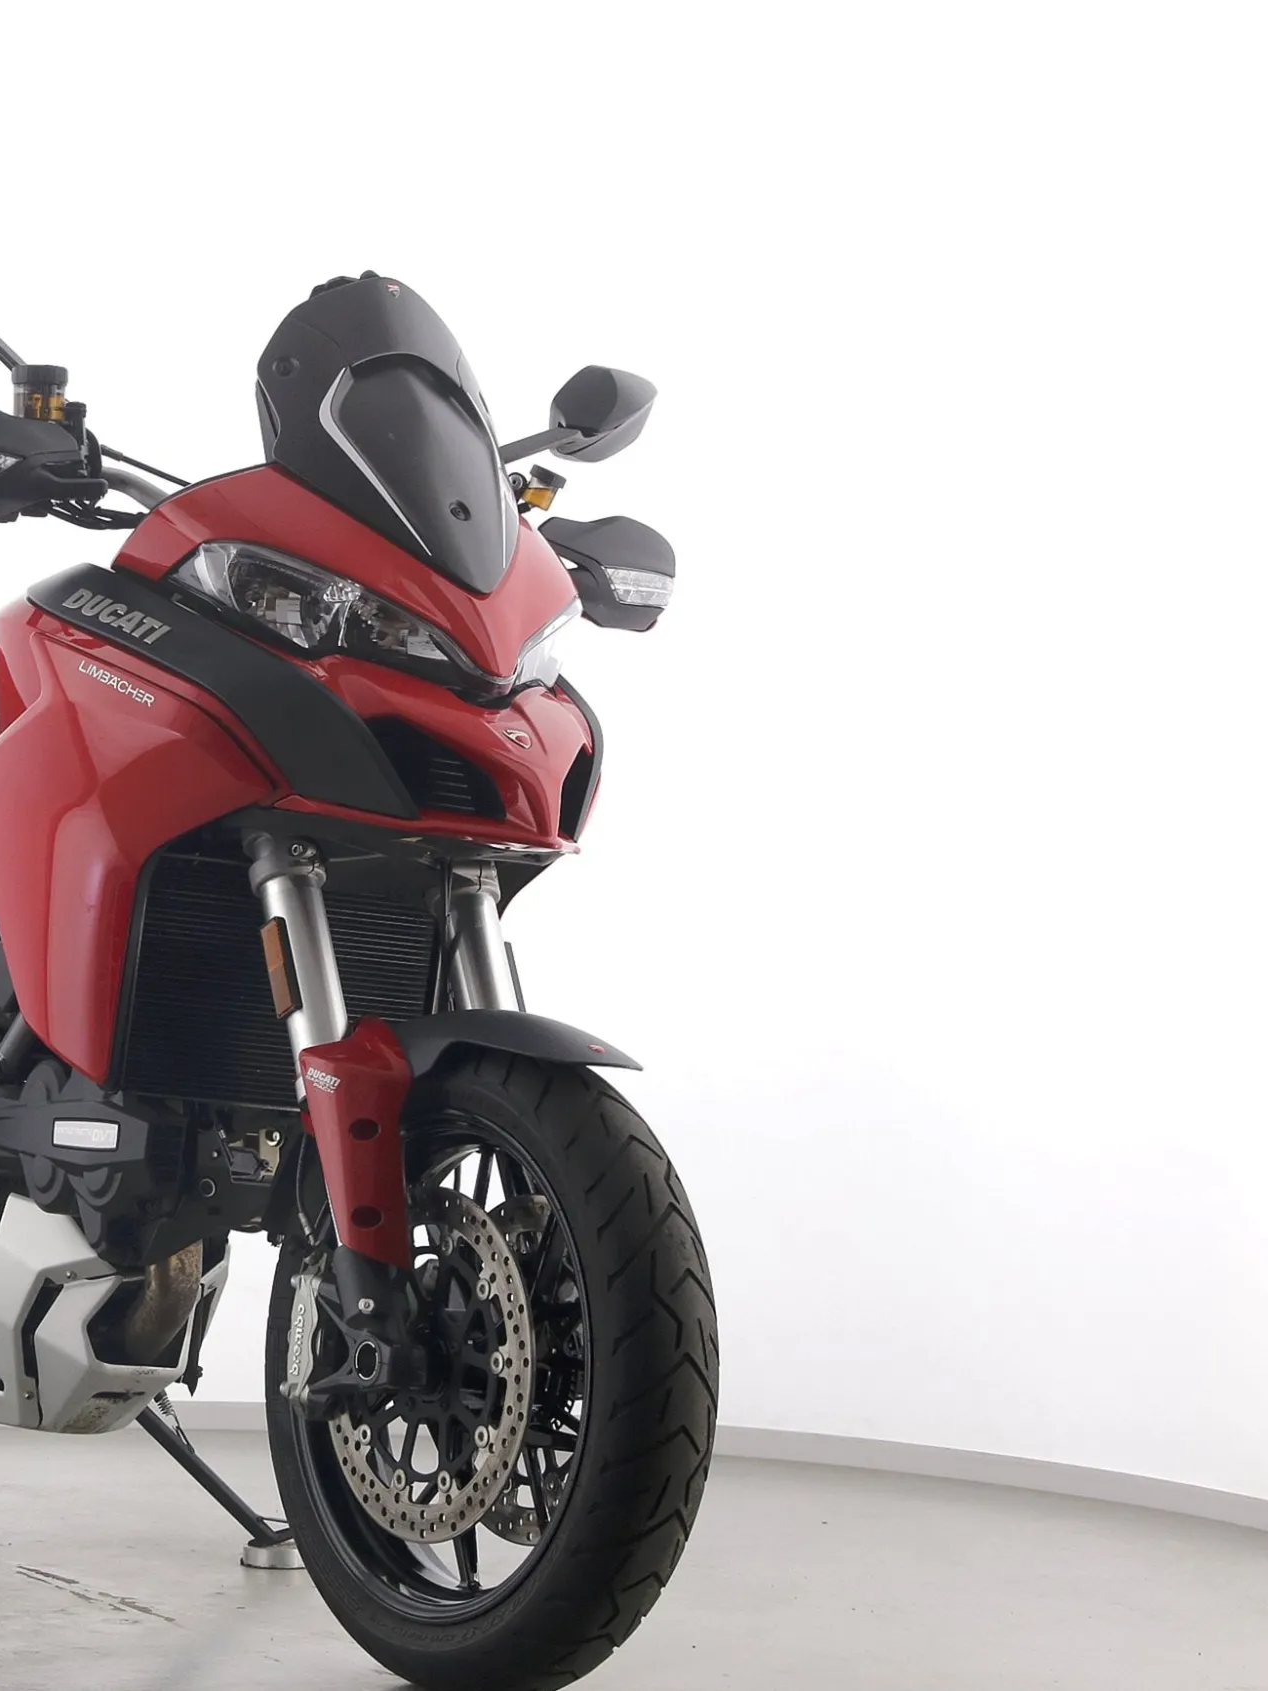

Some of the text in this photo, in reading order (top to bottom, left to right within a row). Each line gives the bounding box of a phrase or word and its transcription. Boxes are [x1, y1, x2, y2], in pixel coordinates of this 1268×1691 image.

[62, 588, 172, 645] DUCATI
[307, 1067, 340, 1087] DUCATI
[289, 1303, 305, 1376] brembo
